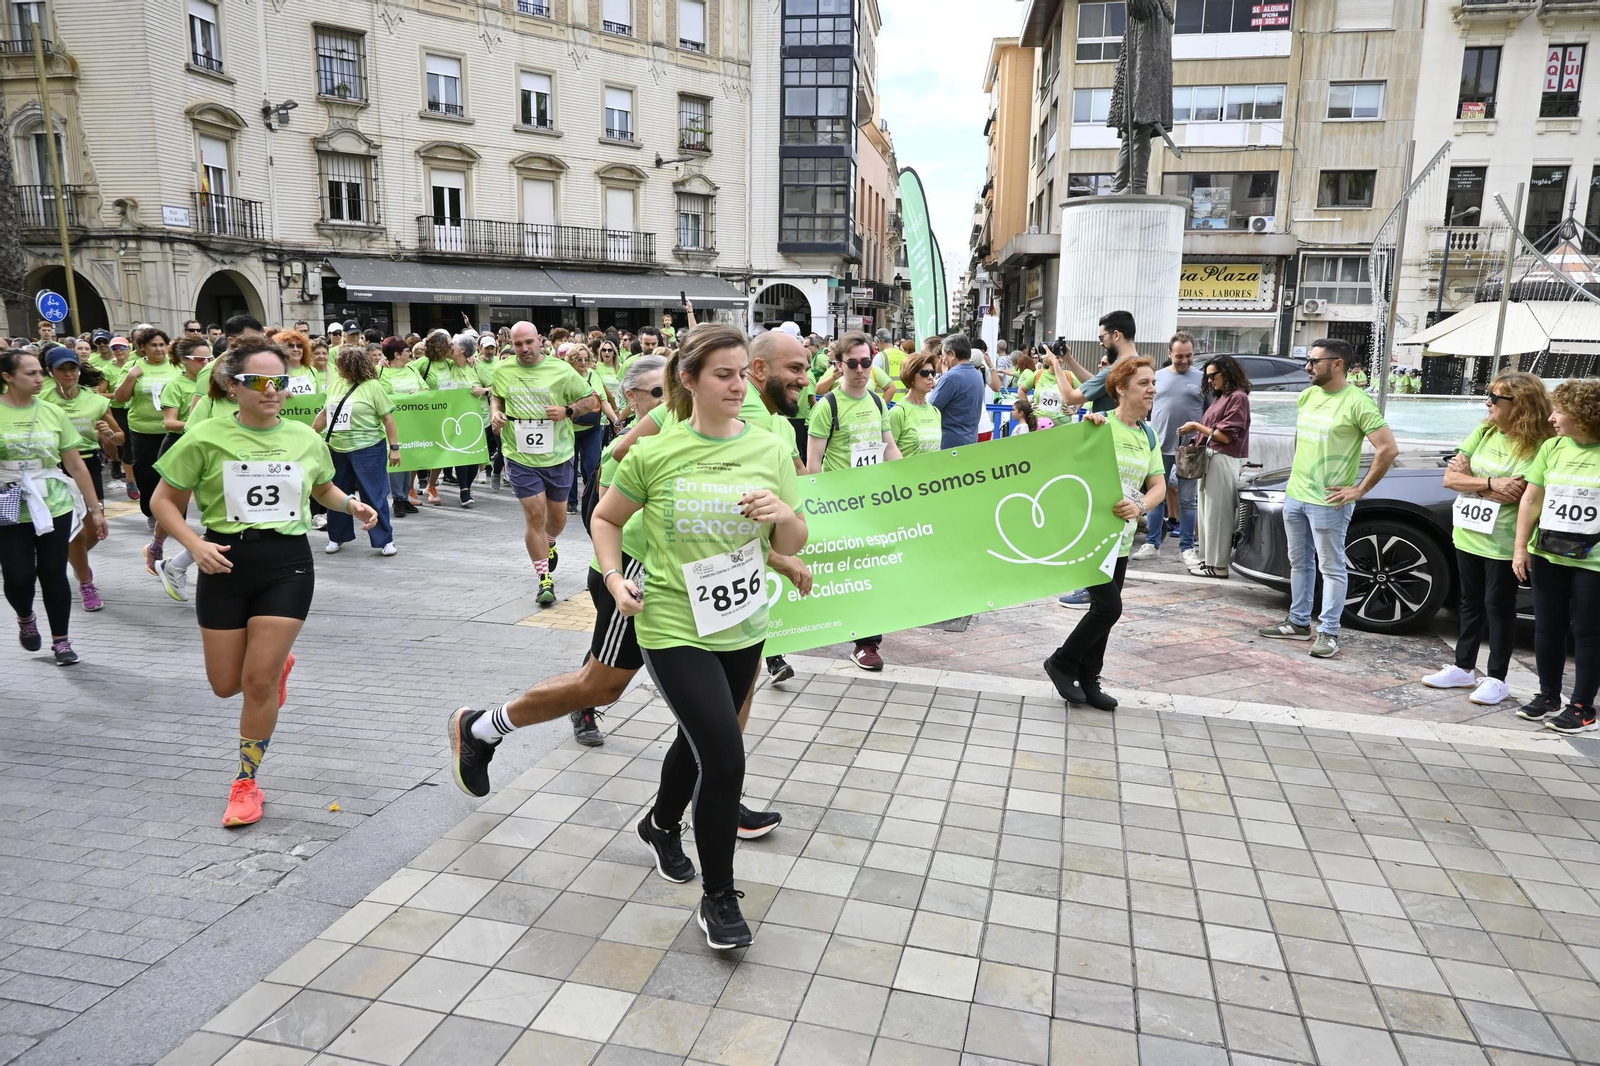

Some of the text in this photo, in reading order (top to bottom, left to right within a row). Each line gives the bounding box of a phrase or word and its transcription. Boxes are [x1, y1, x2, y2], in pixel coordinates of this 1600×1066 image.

[1263, 4, 1289, 12] ALQUILA
[1180, 266, 1260, 282] ia Plaza
[1178, 289, 1252, 298] EDIAS LABORES
[292, 384, 312, 394] 424
[396, 403, 429, 412] somos
[1042, 398, 1058, 406] 201
[278, 406, 311, 416] ontra
[398, 441, 433, 449] Castillejos
[526, 434, 544, 445] 62
[856, 454, 876, 467] 411
[1118, 466, 1142, 477] ontra
[676, 478, 697, 492] En
[804, 460, 1031, 516] Cáncer solo somos uno
[246, 485, 280, 506] 63
[664, 480, 676, 542] HUELVA
[676, 498, 742, 514] contra
[1456, 500, 1493, 522] 2408
[1548, 500, 1598, 522] 2409
[676, 514, 762, 535] cáncer
[796, 523, 934, 556] sociación española
[806, 552, 904, 576] ntra el cáncer
[696, 568, 760, 612] 2856
[810, 578, 872, 598] Calañas
[767, 620, 842, 639] ioncontraelcancer.es
